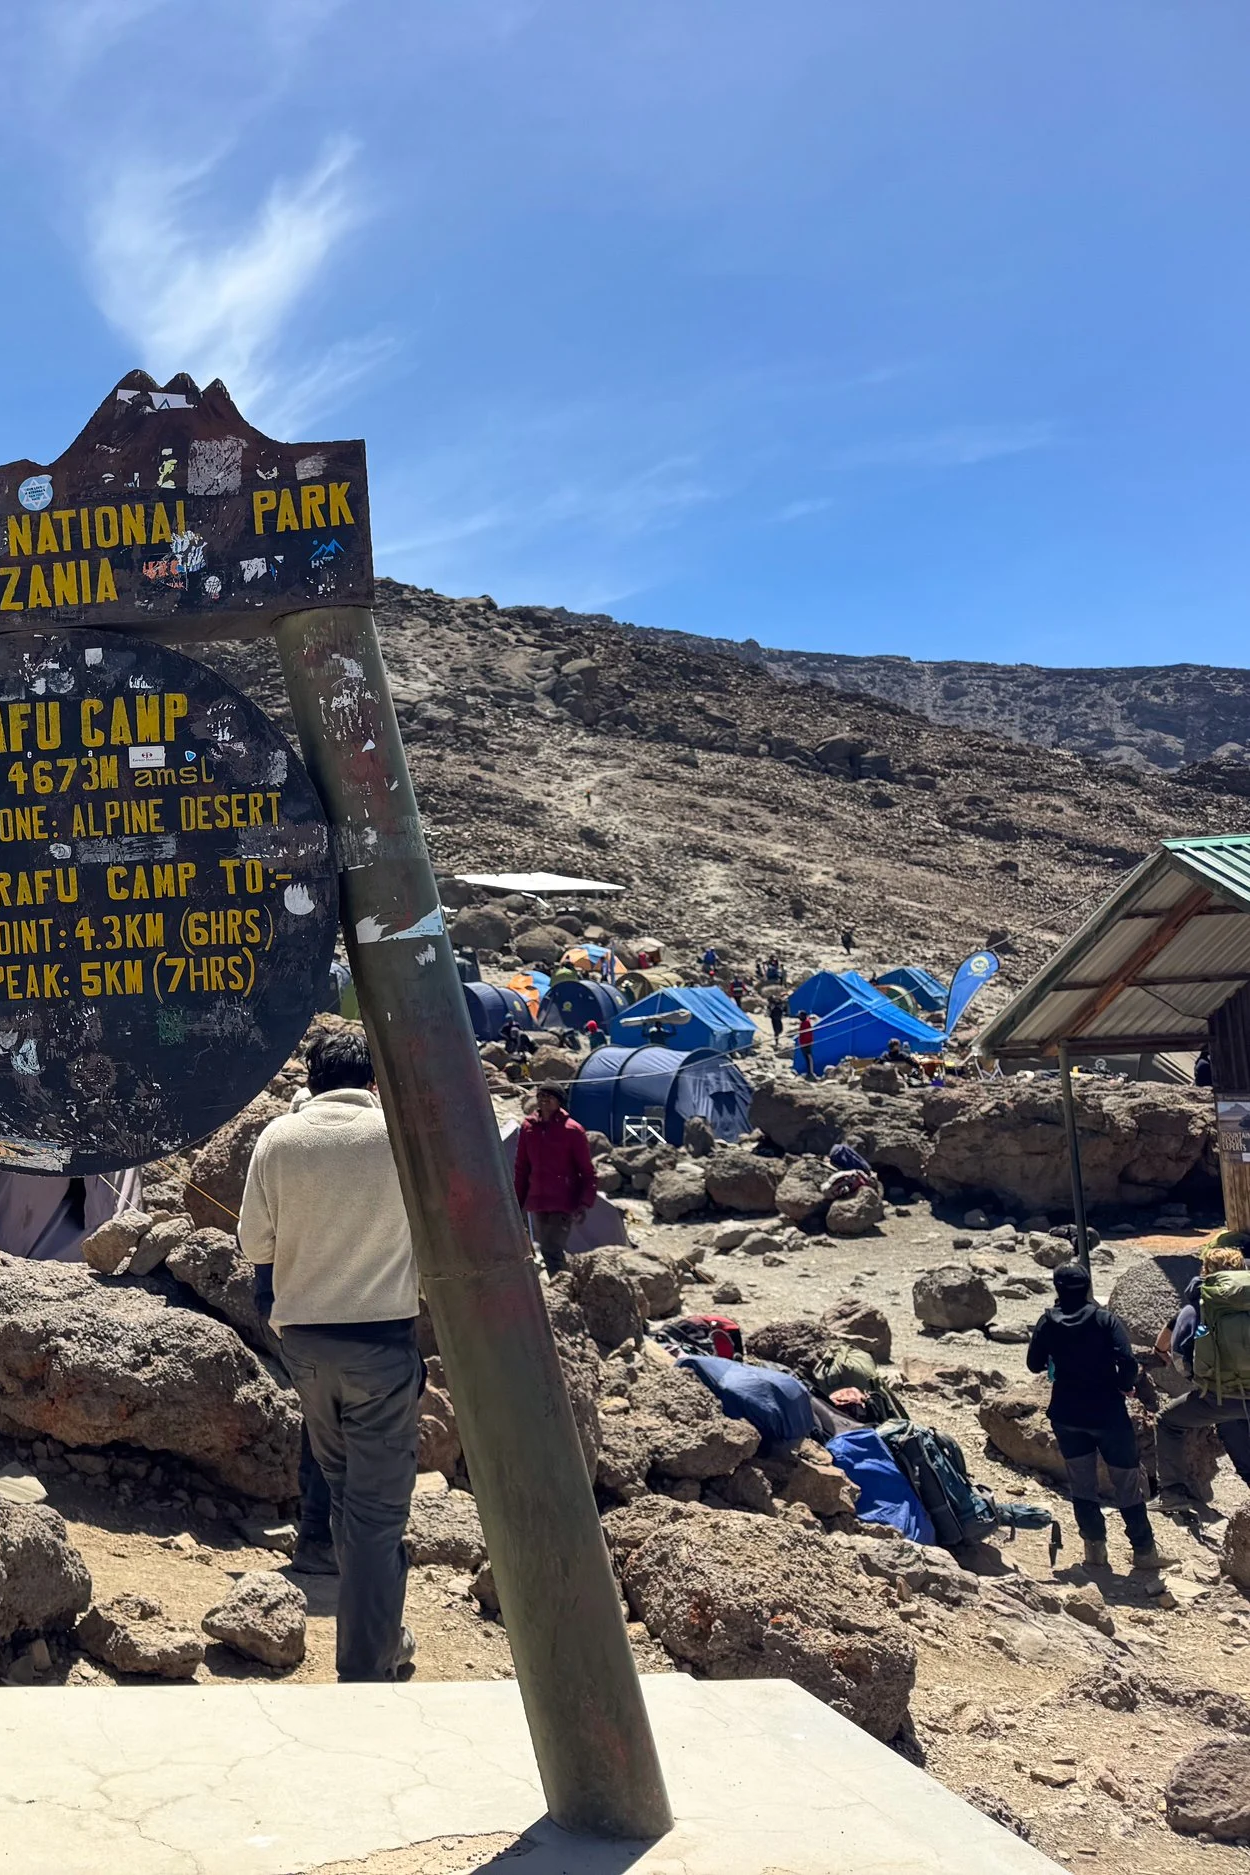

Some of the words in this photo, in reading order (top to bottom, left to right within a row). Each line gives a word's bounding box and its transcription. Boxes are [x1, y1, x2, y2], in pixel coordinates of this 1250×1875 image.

[253, 482, 354, 534] PARK
[81, 693, 187, 747] CAMP
[8, 756, 118, 794] 4673M
[134, 756, 214, 788] amsl
[73, 800, 164, 837] ALPINE
[181, 792, 279, 830] DESERT
[107, 863, 196, 900] CAMP
[75, 913, 164, 950] 4.3KM
[179, 905, 274, 956] (6HRS)
[81, 960, 143, 996] 5KM
[153, 945, 255, 1003] (7HRS)
